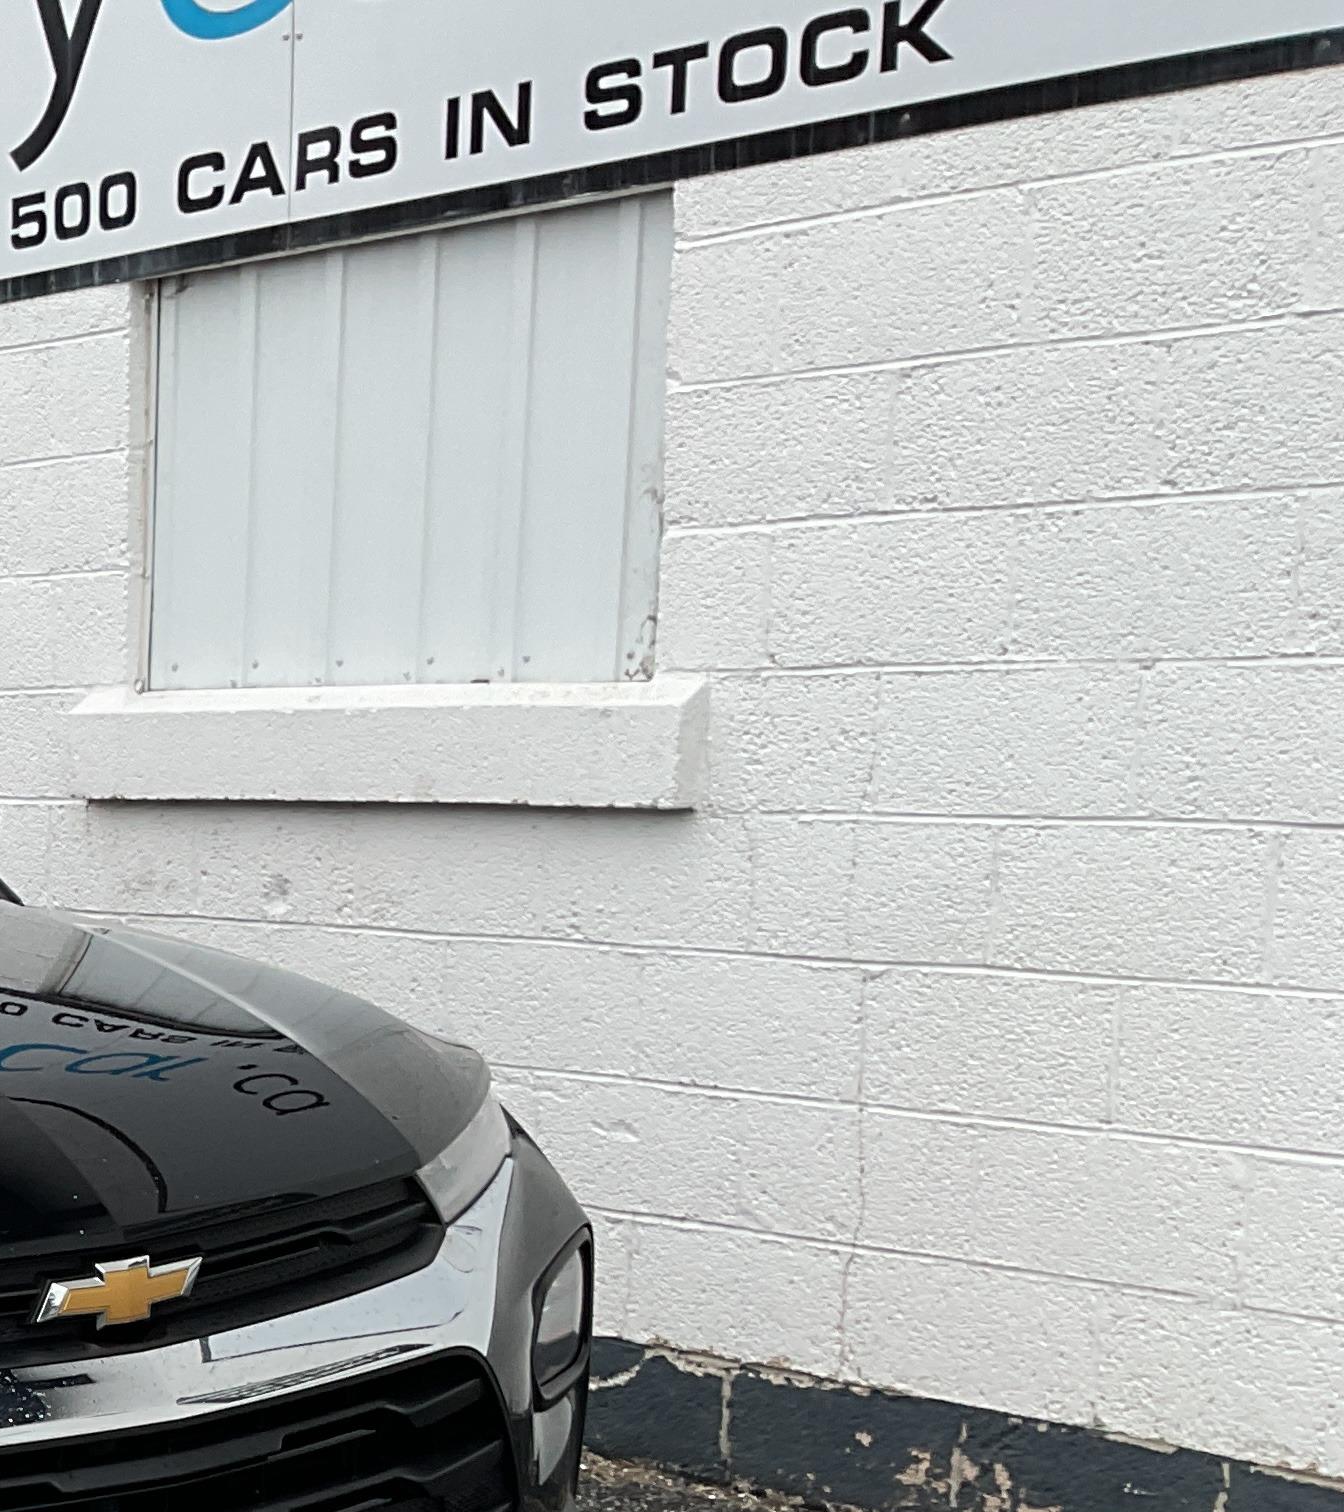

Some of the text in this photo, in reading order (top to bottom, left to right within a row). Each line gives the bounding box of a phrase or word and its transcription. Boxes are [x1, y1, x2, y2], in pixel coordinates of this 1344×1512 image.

[11, 171, 137, 250] 500
[178, 112, 399, 214] CARS
[444, 81, 533, 160] IN
[584, 0, 954, 131] STOCK
